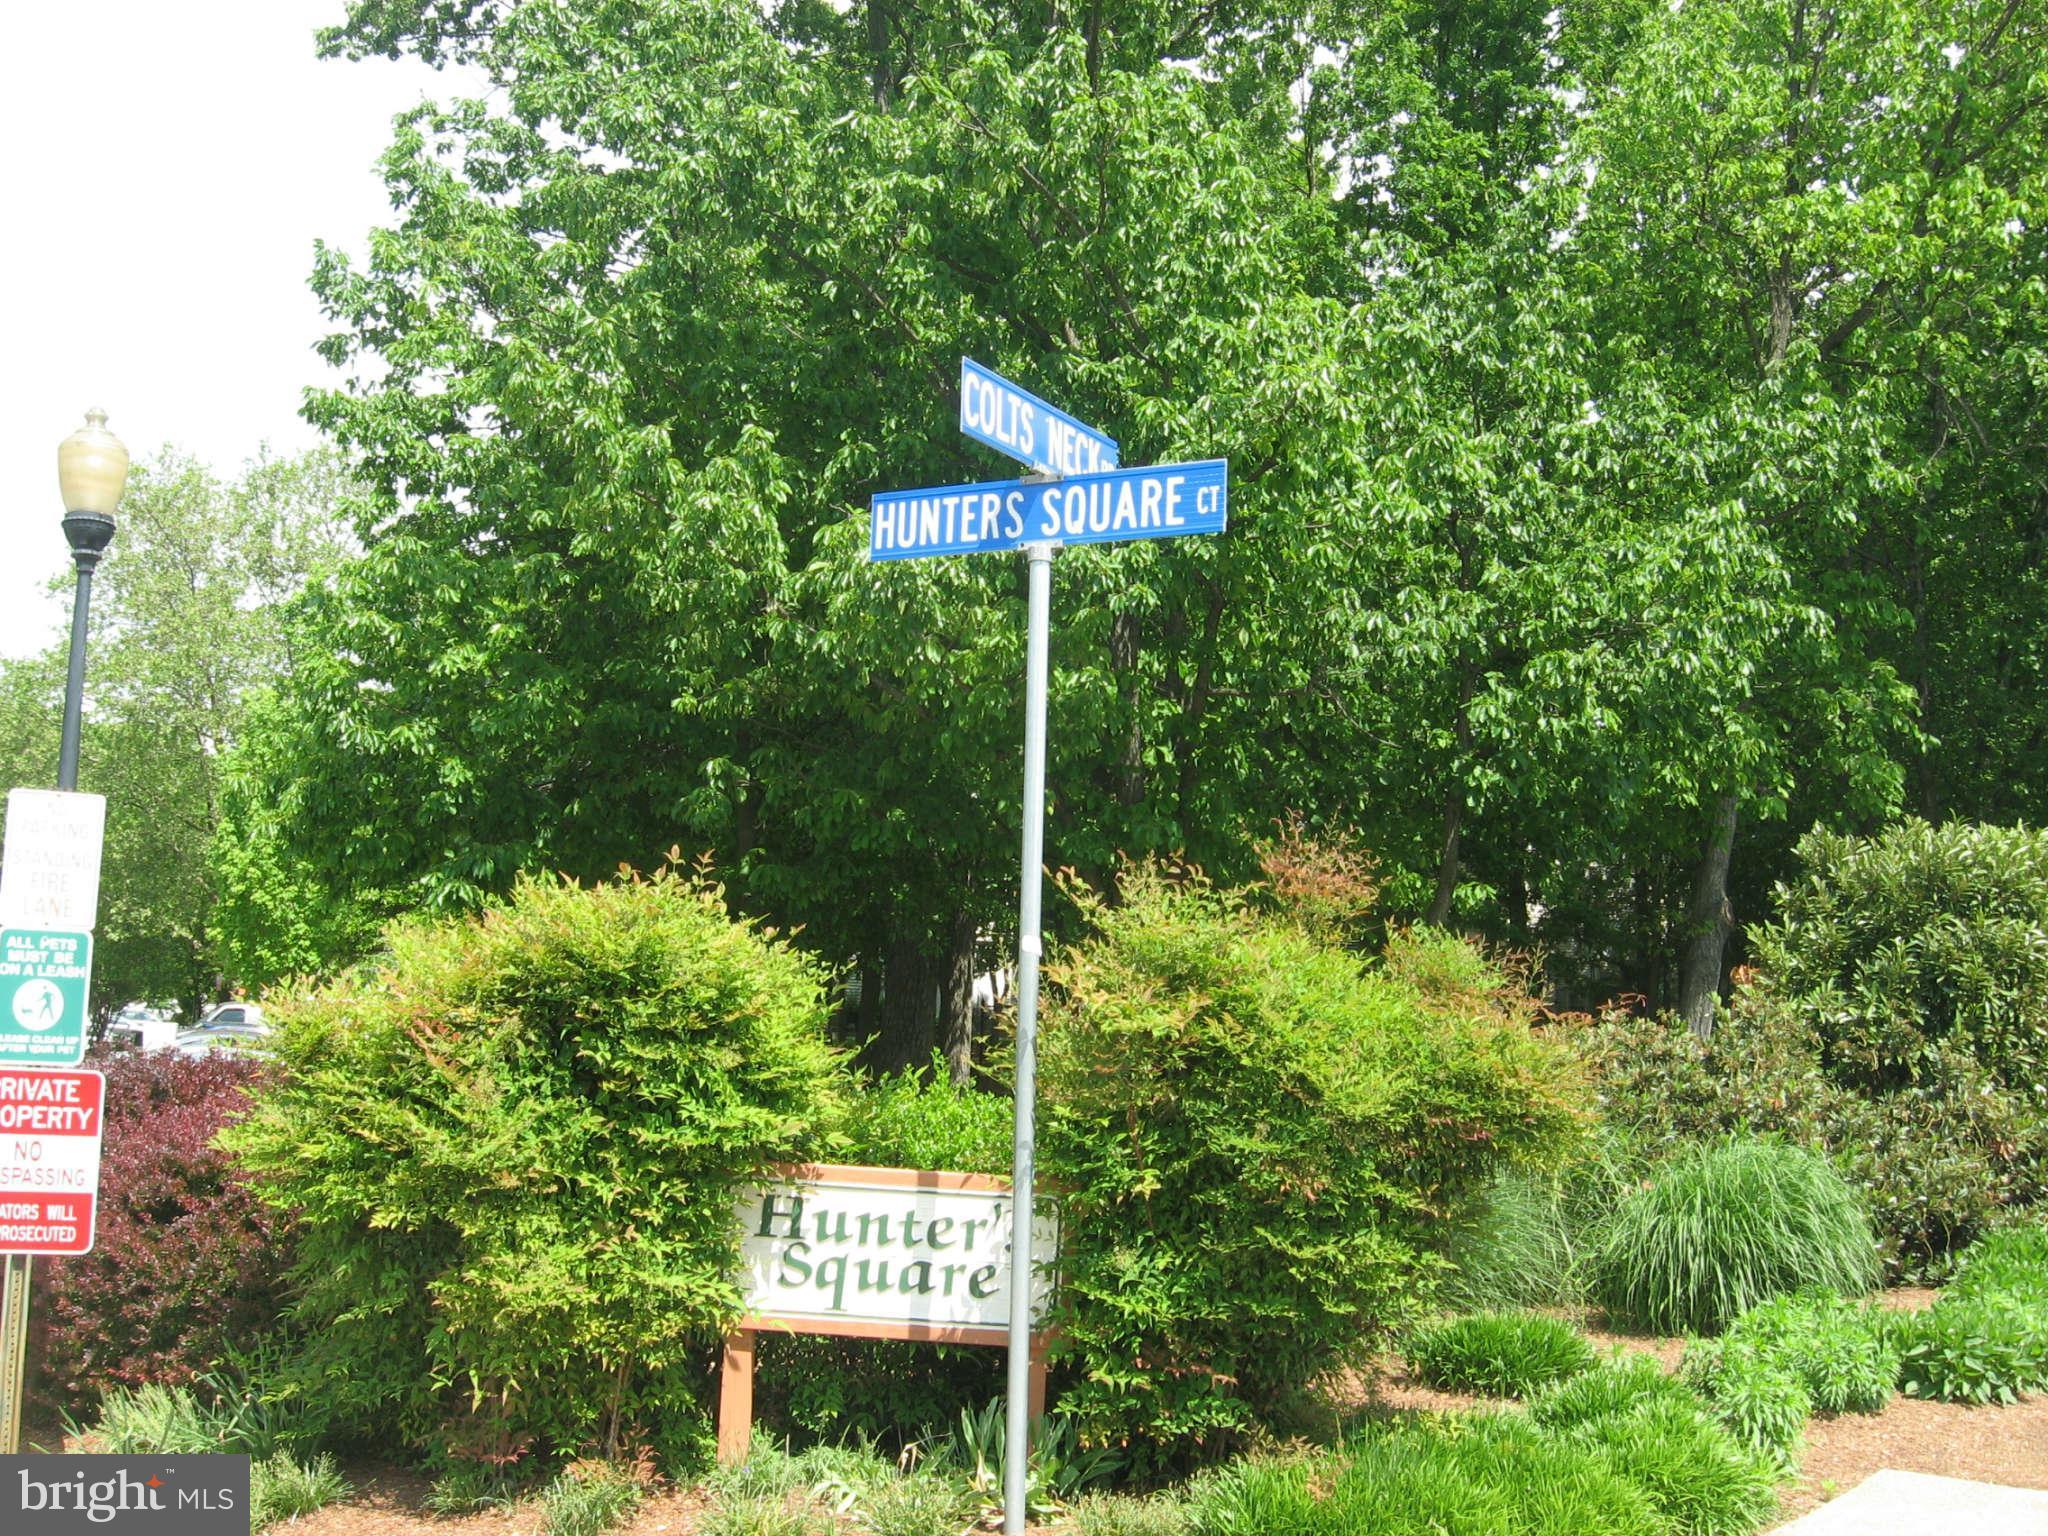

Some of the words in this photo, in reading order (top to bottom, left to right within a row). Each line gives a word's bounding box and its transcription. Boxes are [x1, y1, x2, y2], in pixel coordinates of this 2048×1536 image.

[963, 372, 1034, 455] COLTS
[1046, 418, 1101, 475] NECK
[874, 491, 1025, 550] HUNTERS
[1041, 476, 1185, 538] SQUARE
[1196, 485, 1220, 514] CT
[31, 871, 72, 895] FIRE
[24, 896, 72, 919] LANE
[6, 936, 35, 949] ALL
[40, 937, 78, 952] PETS
[7, 949, 49, 963] MUST
[53, 951, 75, 965] BE
[0, 962, 21, 976] ON
[22, 963, 34, 976] A
[37, 964, 86, 978] LEASH
[0, 1077, 81, 1103] RIVATE
[14, 1141, 42, 1161] NO
[47, 1204, 78, 1221] WILL
[753, 1193, 1014, 1252] Hunter'
[0, 1225, 77, 1243] ROSECUTED
[777, 1241, 1001, 1312] Square
